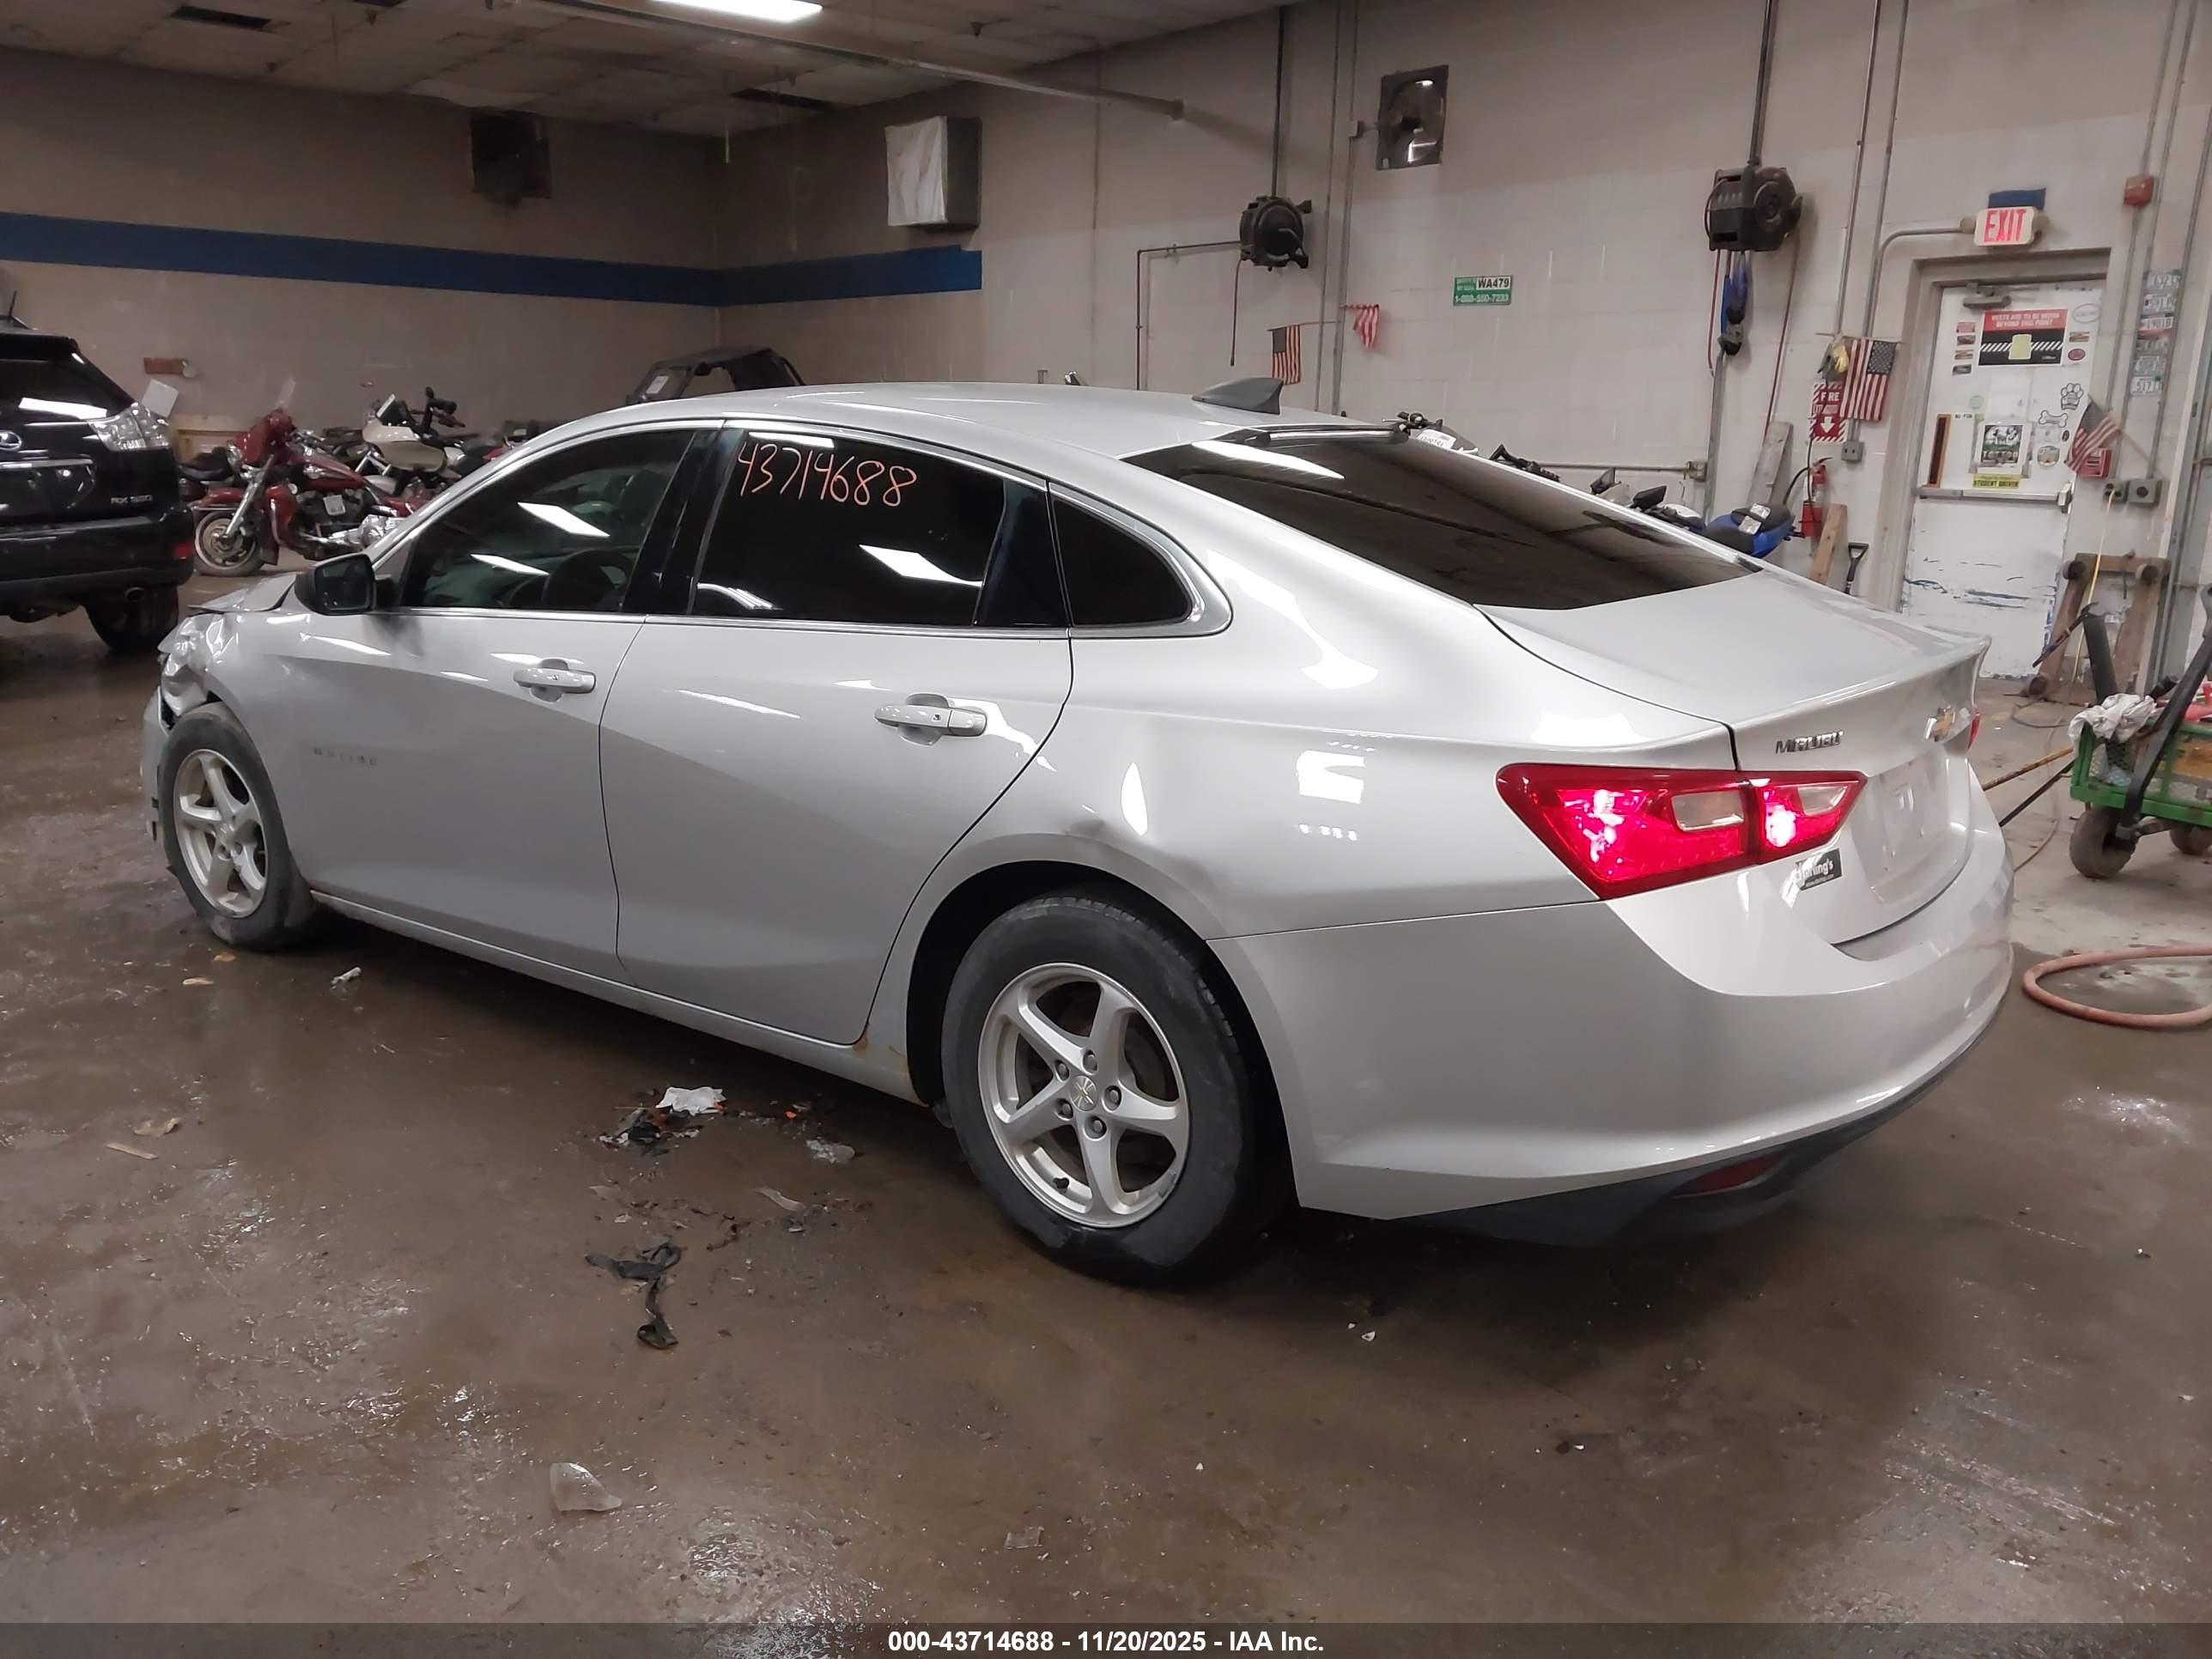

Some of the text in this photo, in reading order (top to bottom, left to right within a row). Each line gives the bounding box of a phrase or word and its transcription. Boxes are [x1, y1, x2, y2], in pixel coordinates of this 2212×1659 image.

[1984, 210, 2027, 242] EXIT
[1477, 277, 1510, 289] WA479
[1820, 392, 1840, 402] FRE
[738, 441, 917, 507] 43714688
[1775, 732, 1844, 754] MALIBU
